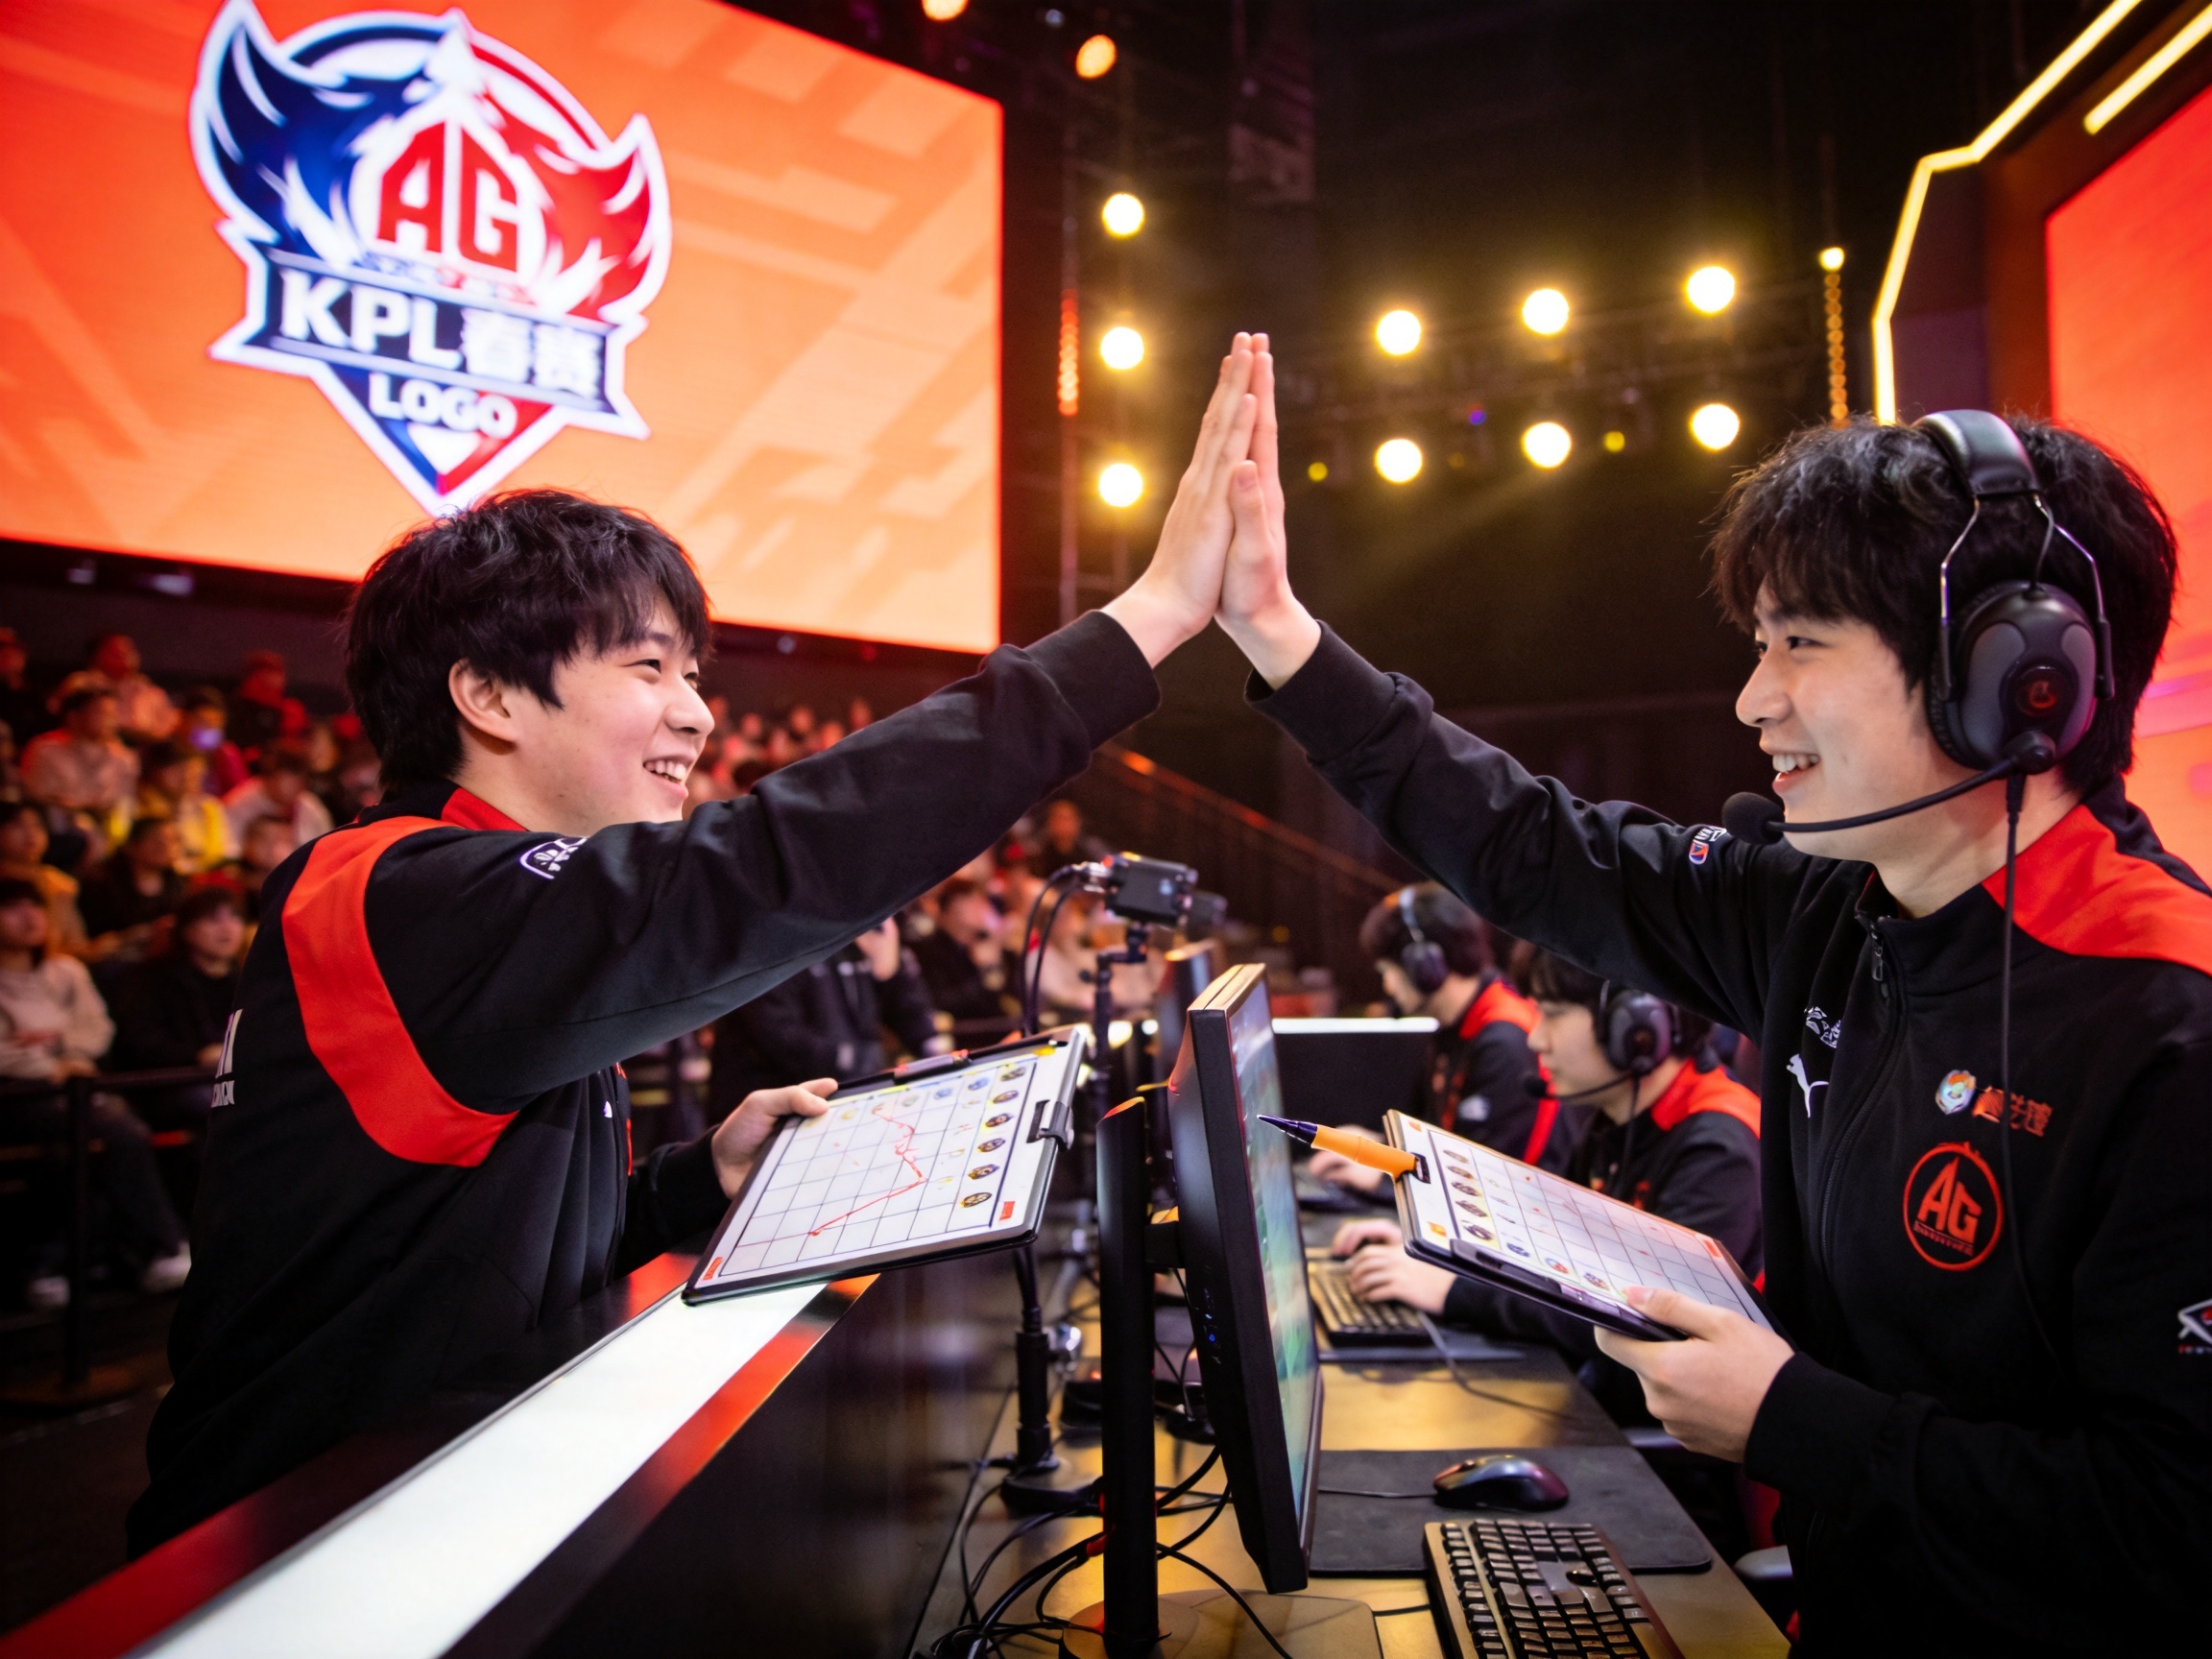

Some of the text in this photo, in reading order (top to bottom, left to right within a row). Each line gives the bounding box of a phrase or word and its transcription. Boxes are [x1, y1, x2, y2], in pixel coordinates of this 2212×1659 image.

[375, 120, 519, 275] AG
[369, 373, 518, 439] LOGO
[1917, 1156, 1983, 1240] AG
